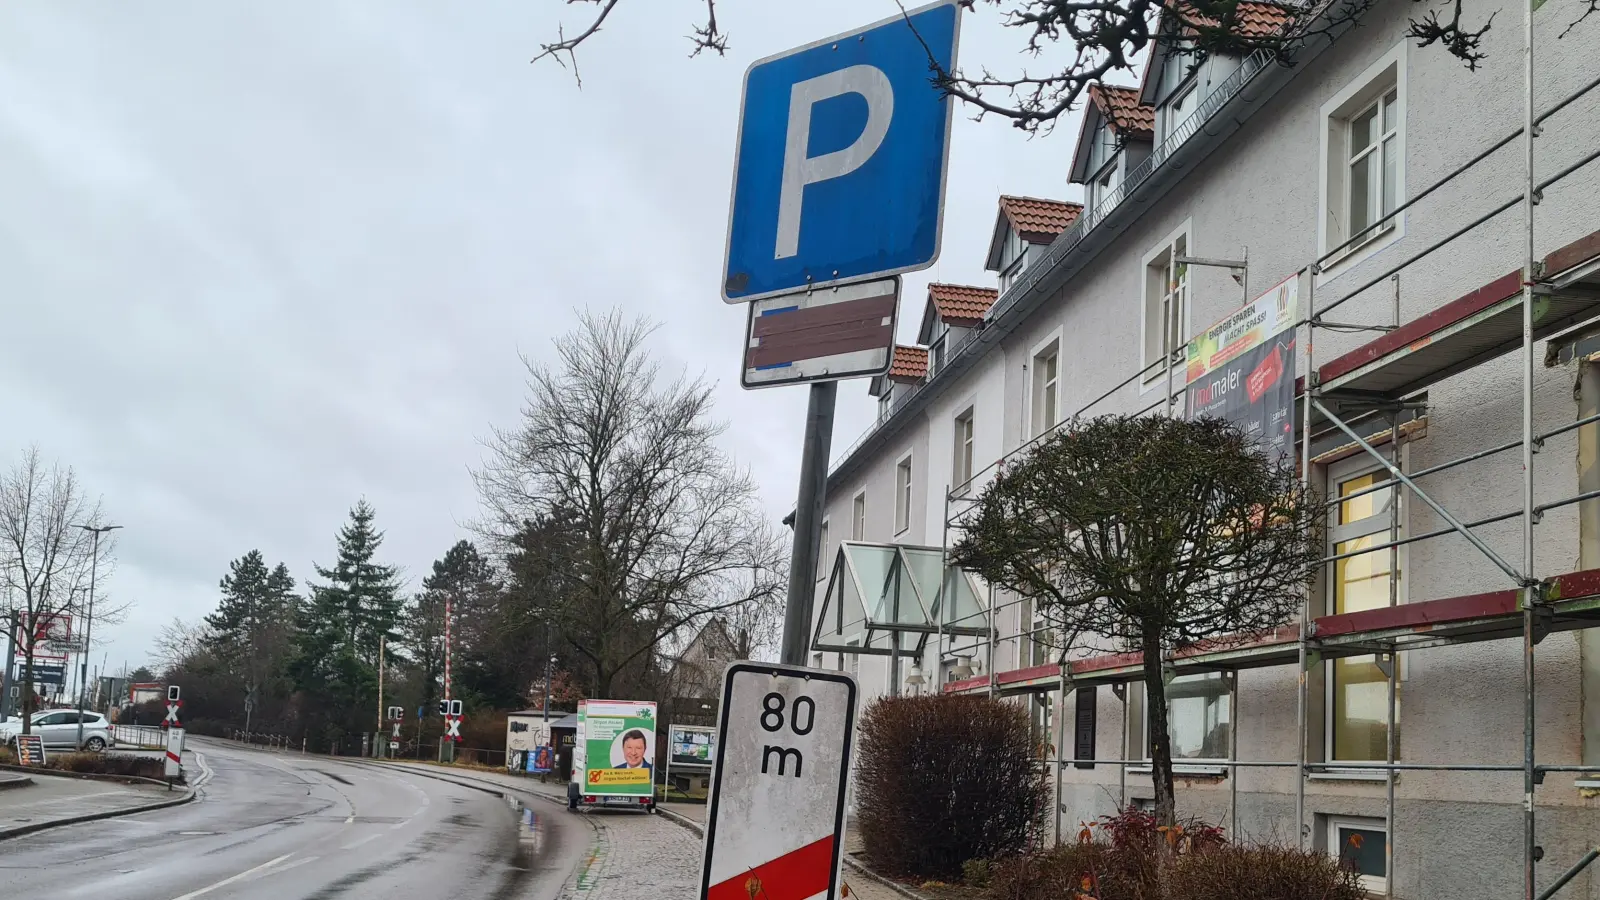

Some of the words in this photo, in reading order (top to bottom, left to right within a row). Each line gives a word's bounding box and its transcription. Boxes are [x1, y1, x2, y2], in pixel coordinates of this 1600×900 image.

[774, 63, 895, 260] P
[1208, 317, 1233, 340] ENERGIE
[1232, 304, 1256, 326] SPAREN
[1223, 324, 1245, 344] MACHT
[1245, 310, 1267, 331] SPASS!
[761, 692, 815, 735] 80
[761, 745, 802, 777] m
